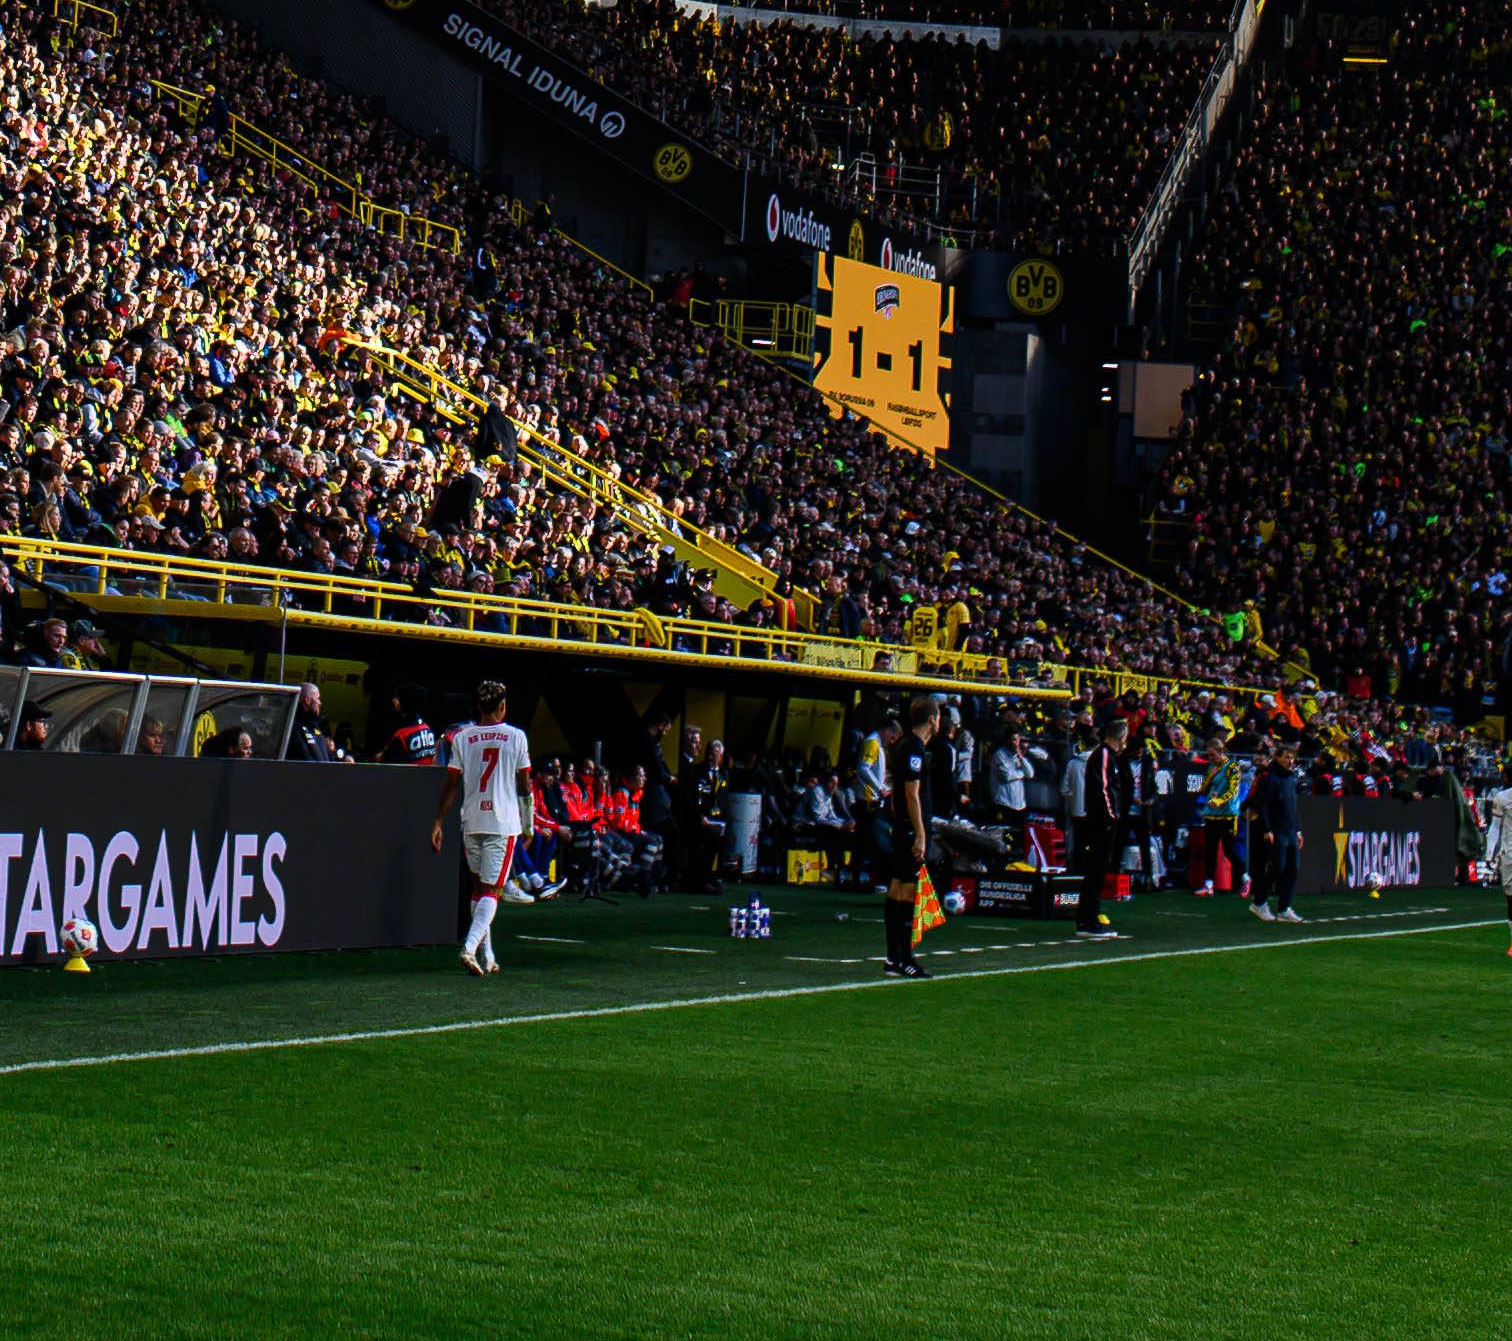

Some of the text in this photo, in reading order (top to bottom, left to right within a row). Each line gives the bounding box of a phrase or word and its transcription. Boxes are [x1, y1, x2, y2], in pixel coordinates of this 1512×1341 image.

[443, 14, 598, 125] SIGNAL IDUNA
[658, 148, 688, 176] BVB
[782, 206, 831, 251] vodafone
[1017, 266, 1057, 298] BVB
[848, 326, 864, 379] 1
[908, 340, 923, 392] 1
[409, 729, 435, 752] atla
[481, 731, 510, 742] LEIPZIG
[479, 747, 501, 793] 7
[1348, 830, 1421, 889] STARGAMES
